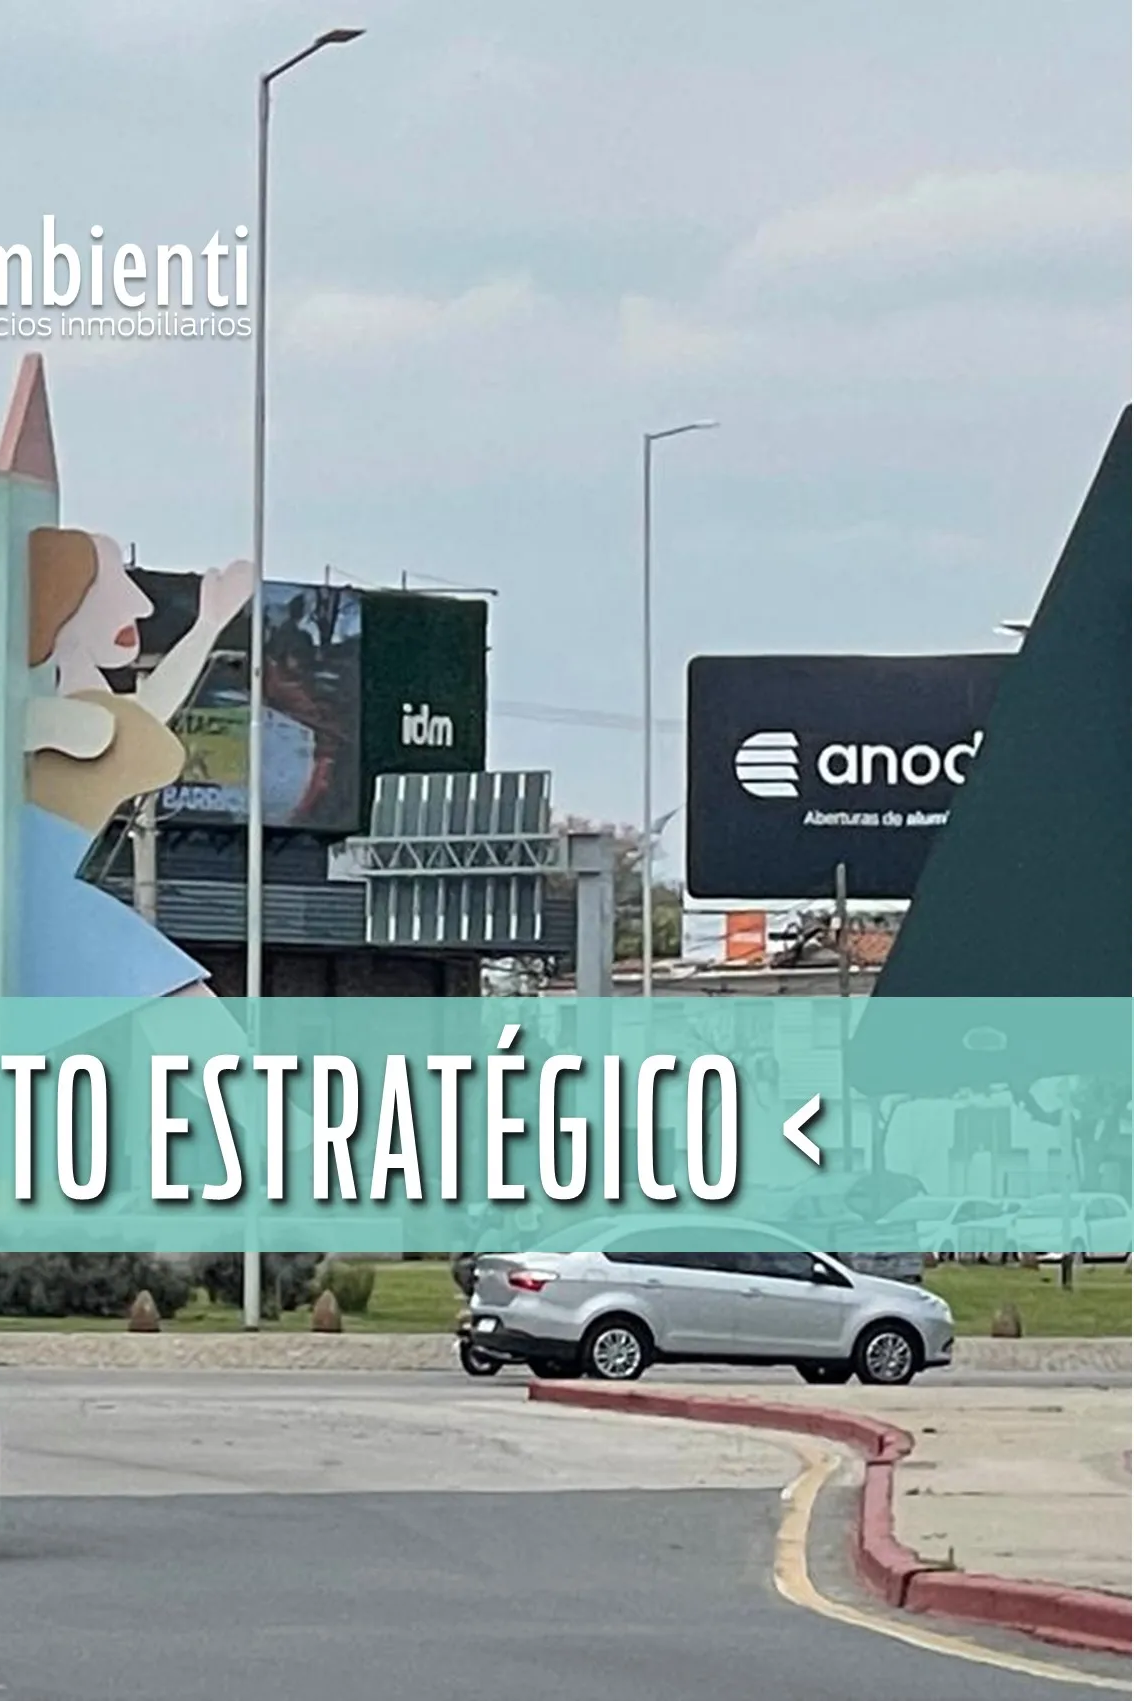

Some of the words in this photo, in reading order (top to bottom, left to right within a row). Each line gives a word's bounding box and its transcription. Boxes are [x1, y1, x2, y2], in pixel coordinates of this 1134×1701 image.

[402, 704, 453, 747] idm
[803, 810, 880, 826] Aberturas
[882, 811, 903, 826] de
